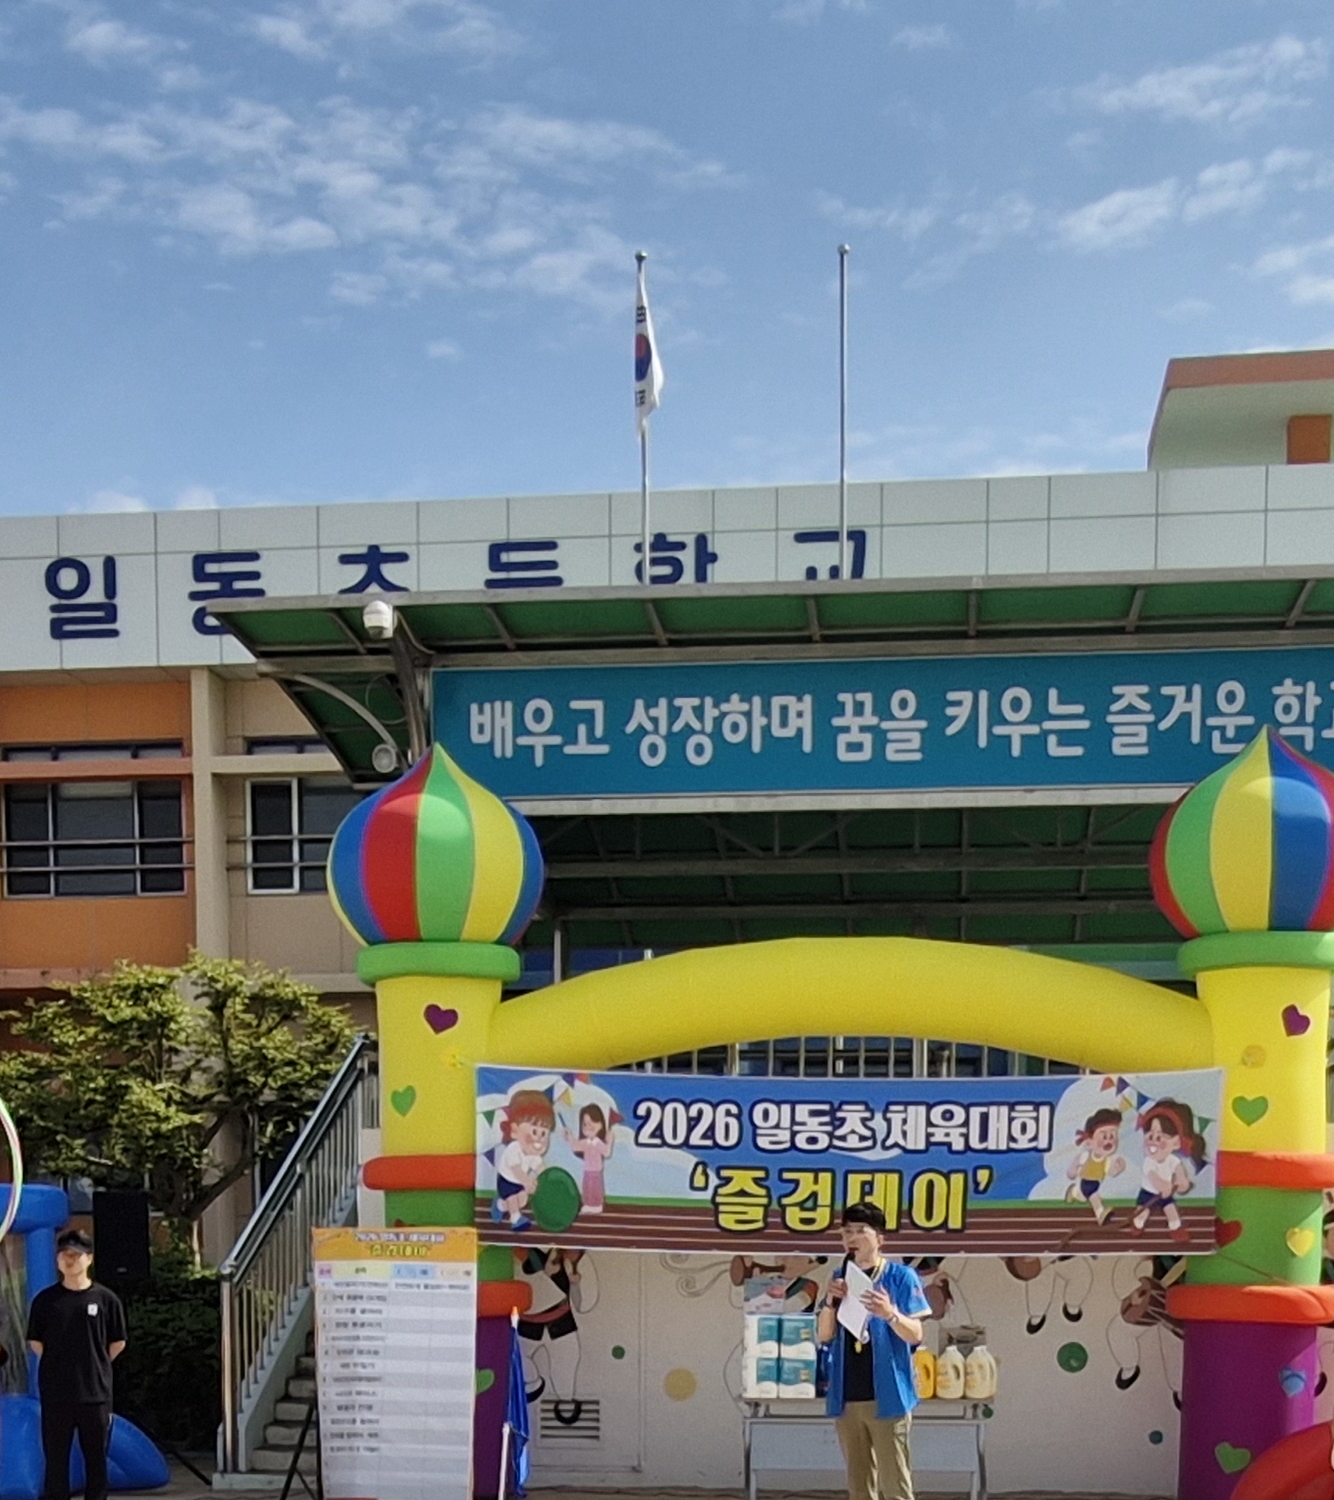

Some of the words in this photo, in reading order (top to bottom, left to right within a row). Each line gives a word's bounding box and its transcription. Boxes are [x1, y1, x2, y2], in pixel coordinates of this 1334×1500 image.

[469, 697, 610, 767] 배우고
[625, 692, 813, 767] 성장하며
[831, 689, 928, 763] 꿈을
[943, 686, 1091, 758] 키우는
[1105, 679, 1255, 756] 즐거운
[634, 1100, 740, 1149] 2026
[751, 1101, 877, 1151] 일동초
[885, 1101, 1054, 1152] 체육대회
